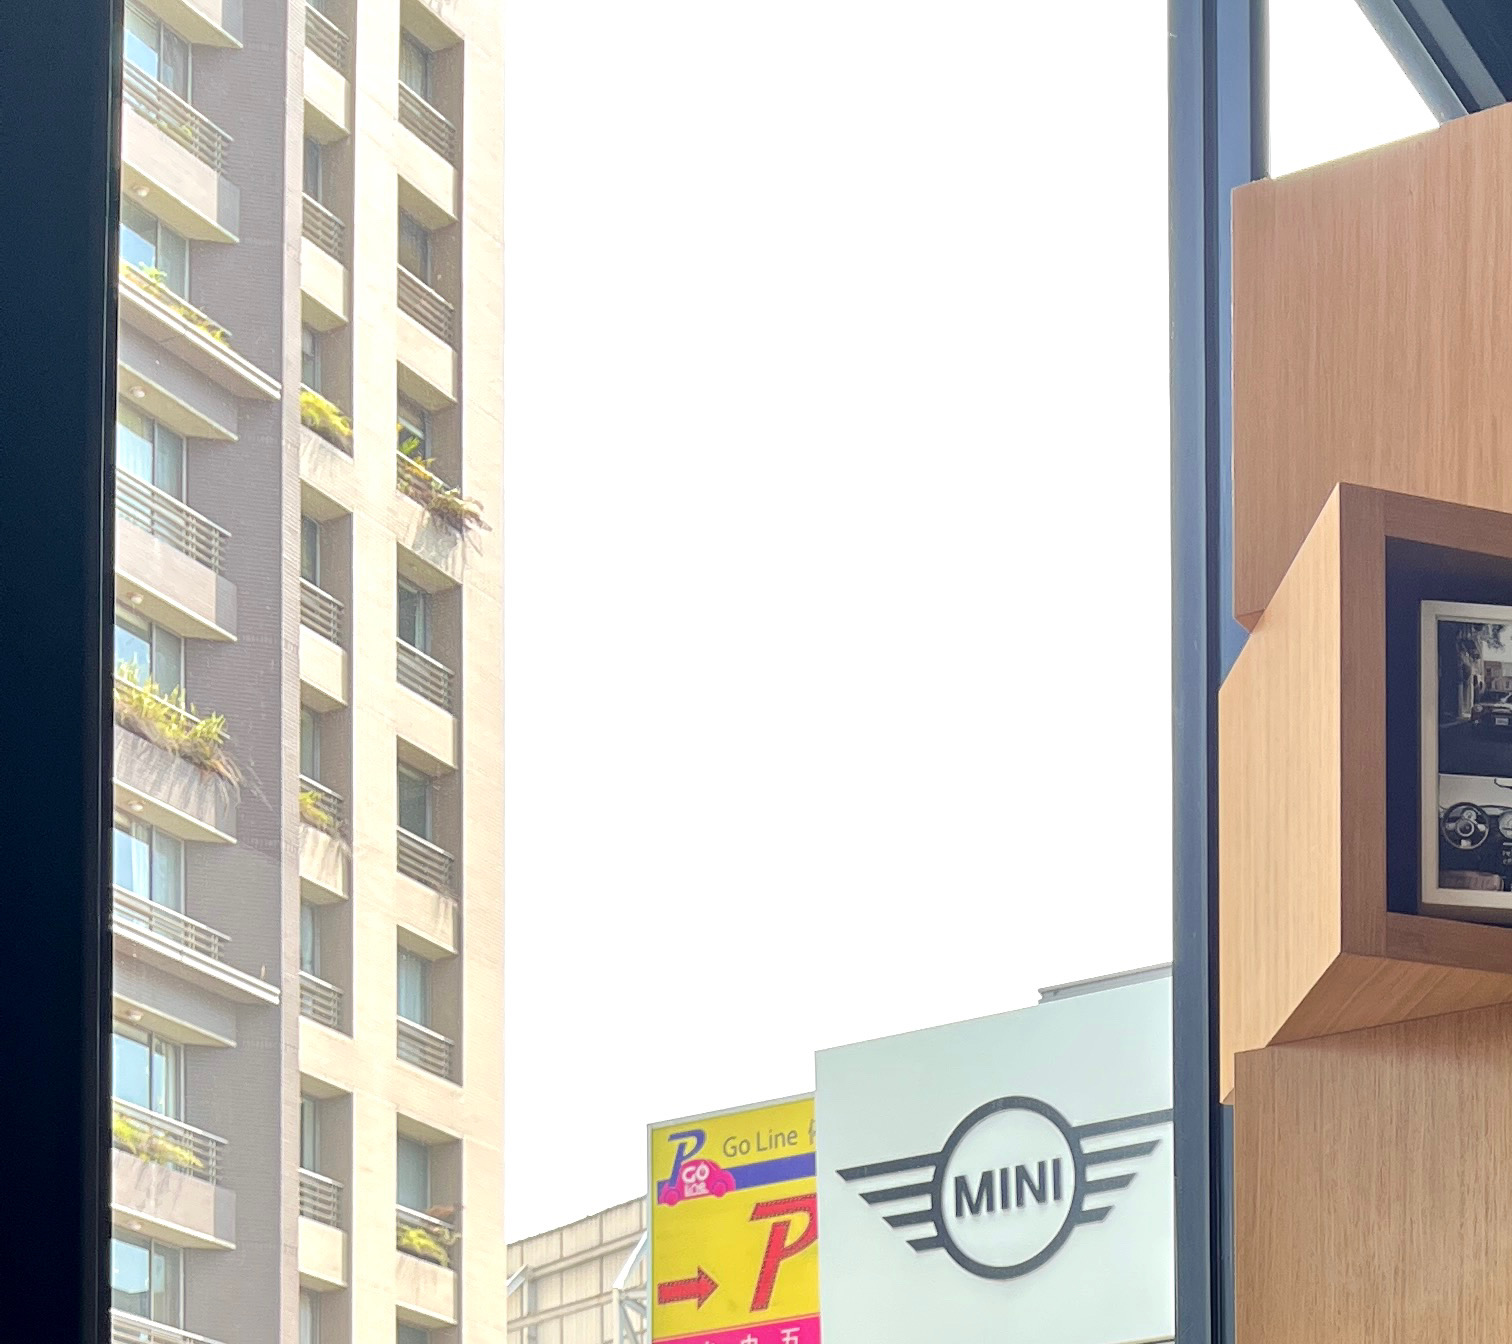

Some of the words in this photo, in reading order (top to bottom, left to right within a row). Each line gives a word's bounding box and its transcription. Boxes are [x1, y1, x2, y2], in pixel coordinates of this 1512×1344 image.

[722, 1136, 750, 1158] Go
[756, 1129, 798, 1152] Line
[954, 1157, 1062, 1218] MINI
[749, 1192, 818, 1313] P
